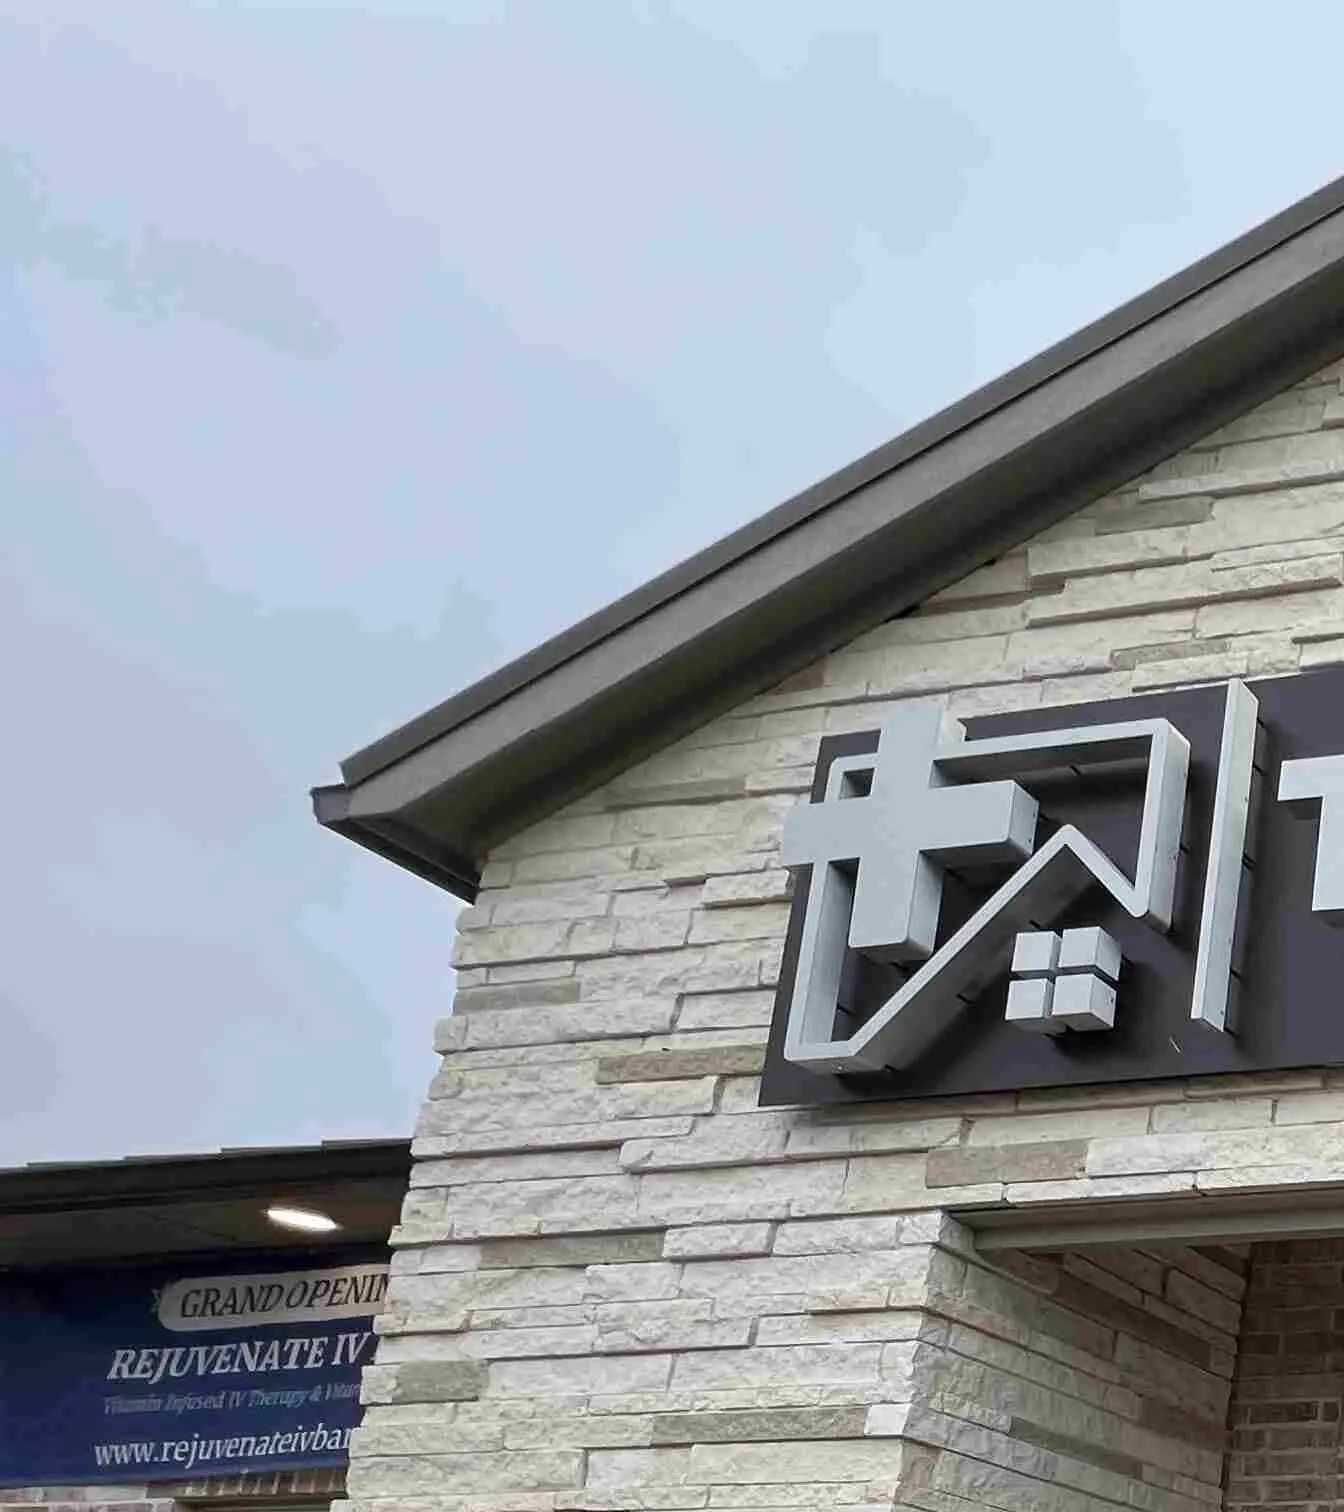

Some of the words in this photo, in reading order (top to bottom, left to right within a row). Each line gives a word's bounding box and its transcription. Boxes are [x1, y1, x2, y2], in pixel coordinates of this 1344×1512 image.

[180, 1283, 284, 1318] GRAND
[106, 1336, 329, 1385] REJUVENATE
[331, 1331, 372, 1366] IV
